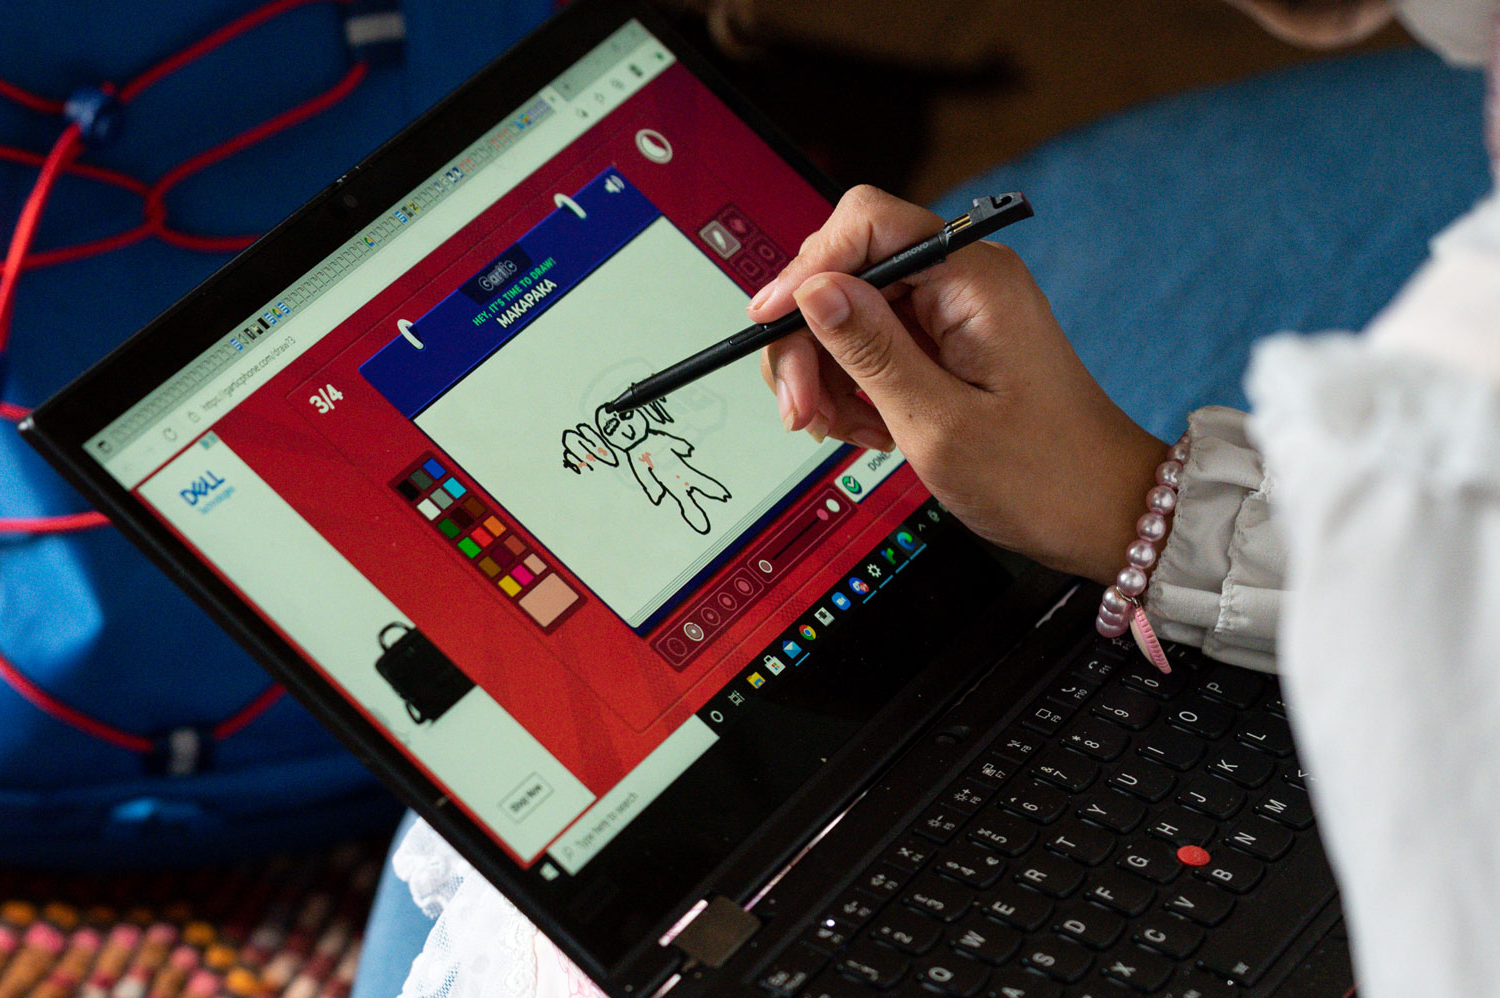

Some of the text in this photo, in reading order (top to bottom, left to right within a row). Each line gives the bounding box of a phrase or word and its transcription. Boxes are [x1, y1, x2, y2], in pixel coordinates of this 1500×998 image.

[893, 241, 929, 264] Lenovo
[472, 256, 557, 326] HEY, IT'S TIME TO DRAW!
[496, 278, 558, 329] MAKAPAKA
[309, 384, 344, 414] 3/4
[1143, 678, 1160, 688] 0
[1206, 681, 1223, 694] P
[1113, 708, 1131, 719] 9
[1178, 710, 1199, 723] O
[1246, 732, 1267, 741] L
[1083, 739, 1101, 750] 8
[1147, 746, 1165, 755] I
[1216, 759, 1239, 773] K
[1052, 770, 1069, 780] 7
[1116, 772, 1138, 786] U
[1189, 791, 1207, 803] J
[1022, 802, 1040, 812] 6
[1086, 803, 1107, 815] Y
[1263, 798, 1288, 814] M
[1155, 822, 1179, 836] H
[990, 833, 1008, 844] 5
[1055, 835, 1077, 848] T
[1233, 831, 1257, 846] N
[1126, 855, 1149, 868] G
[1023, 868, 1048, 882] R
[1211, 868, 1234, 882] B
[1095, 886, 1114, 900] F
[991, 901, 1016, 916] E
[1173, 895, 1195, 909] V
[1063, 919, 1086, 934] D
[960, 930, 987, 949] W
[1144, 928, 1167, 943] C
[1032, 952, 1056, 967] S
[1110, 961, 1137, 977] X
